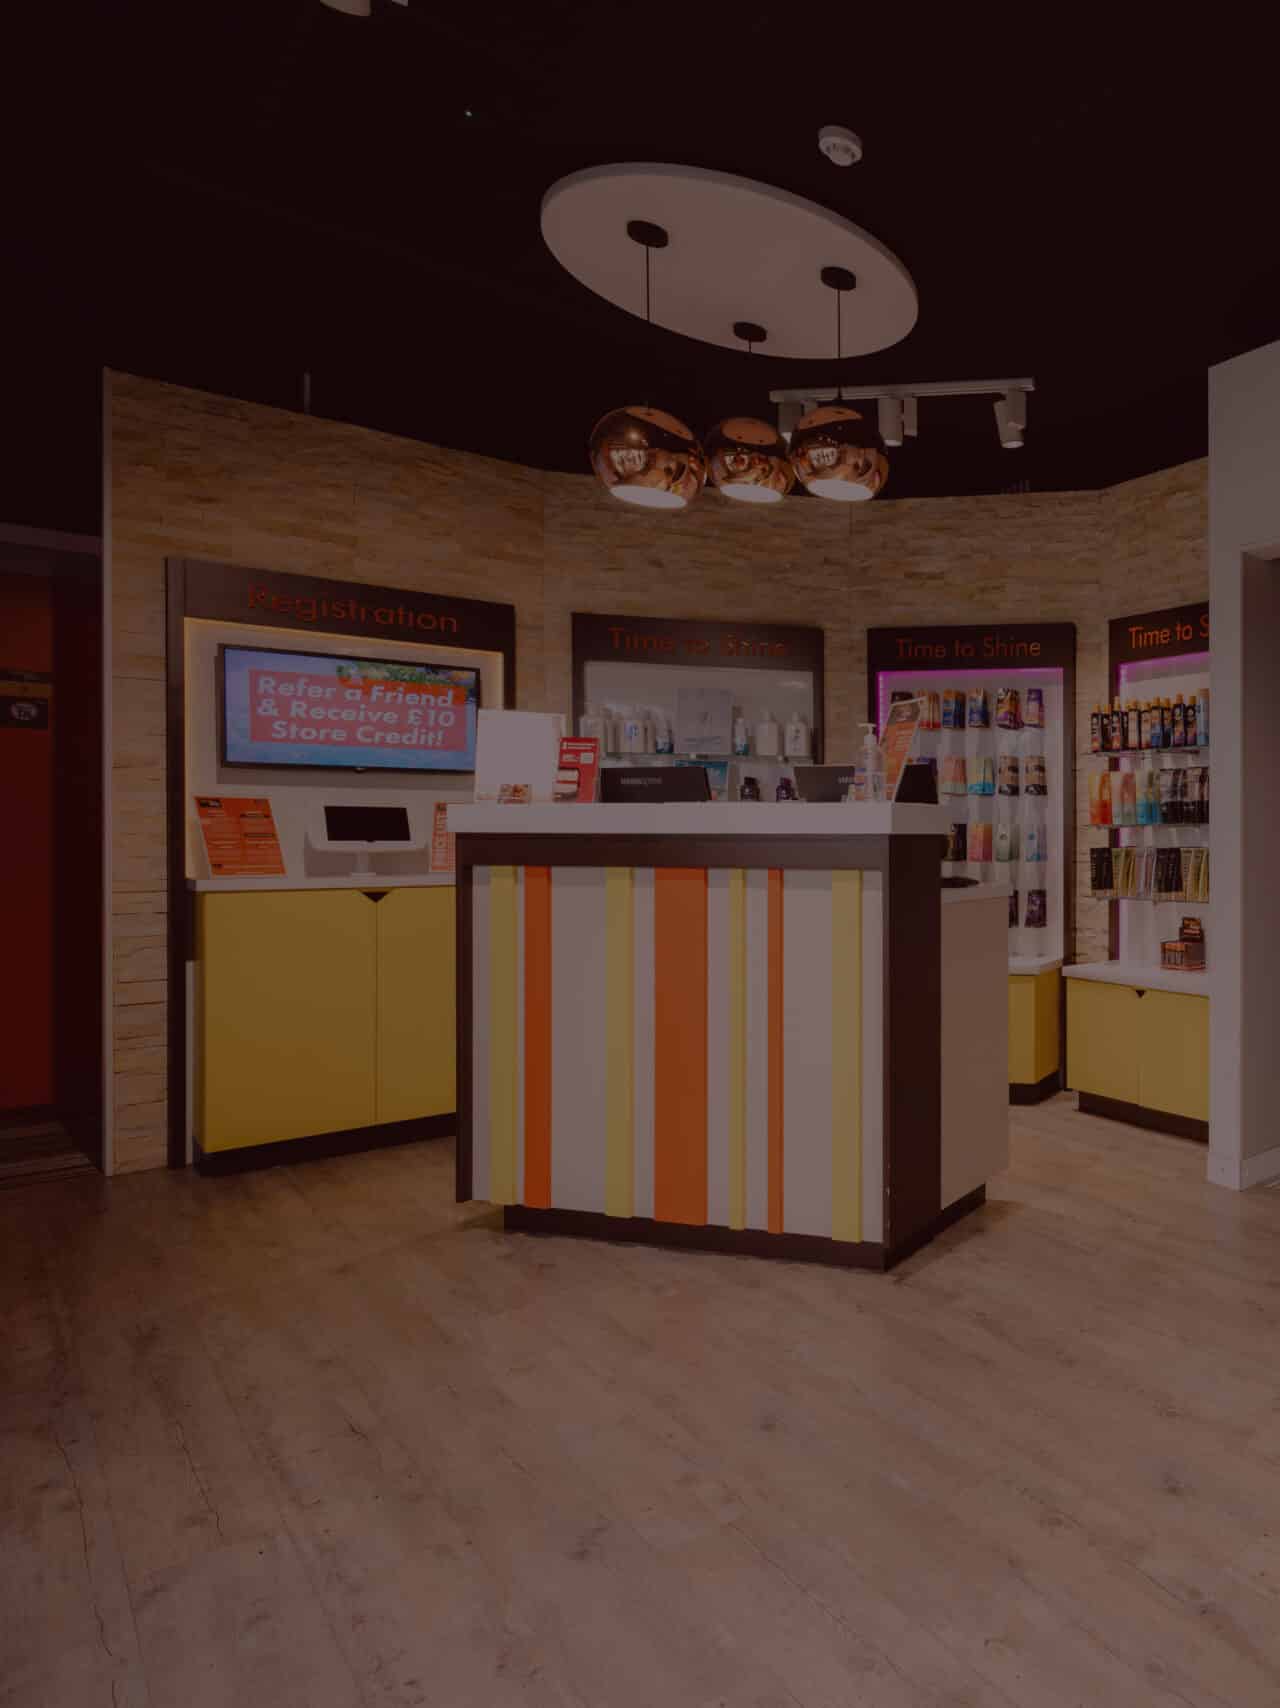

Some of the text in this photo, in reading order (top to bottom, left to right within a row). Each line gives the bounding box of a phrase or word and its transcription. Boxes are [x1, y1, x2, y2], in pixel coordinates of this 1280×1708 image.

[248, 583, 459, 633] Registration
[896, 632, 1041, 658] Time to Shine
[1127, 624, 1170, 649] Time
[1175, 617, 1193, 641] to
[256, 675, 454, 708] Refer a Friend
[256, 698, 456, 728] & Receive £10
[271, 720, 444, 746] Store Credit!
